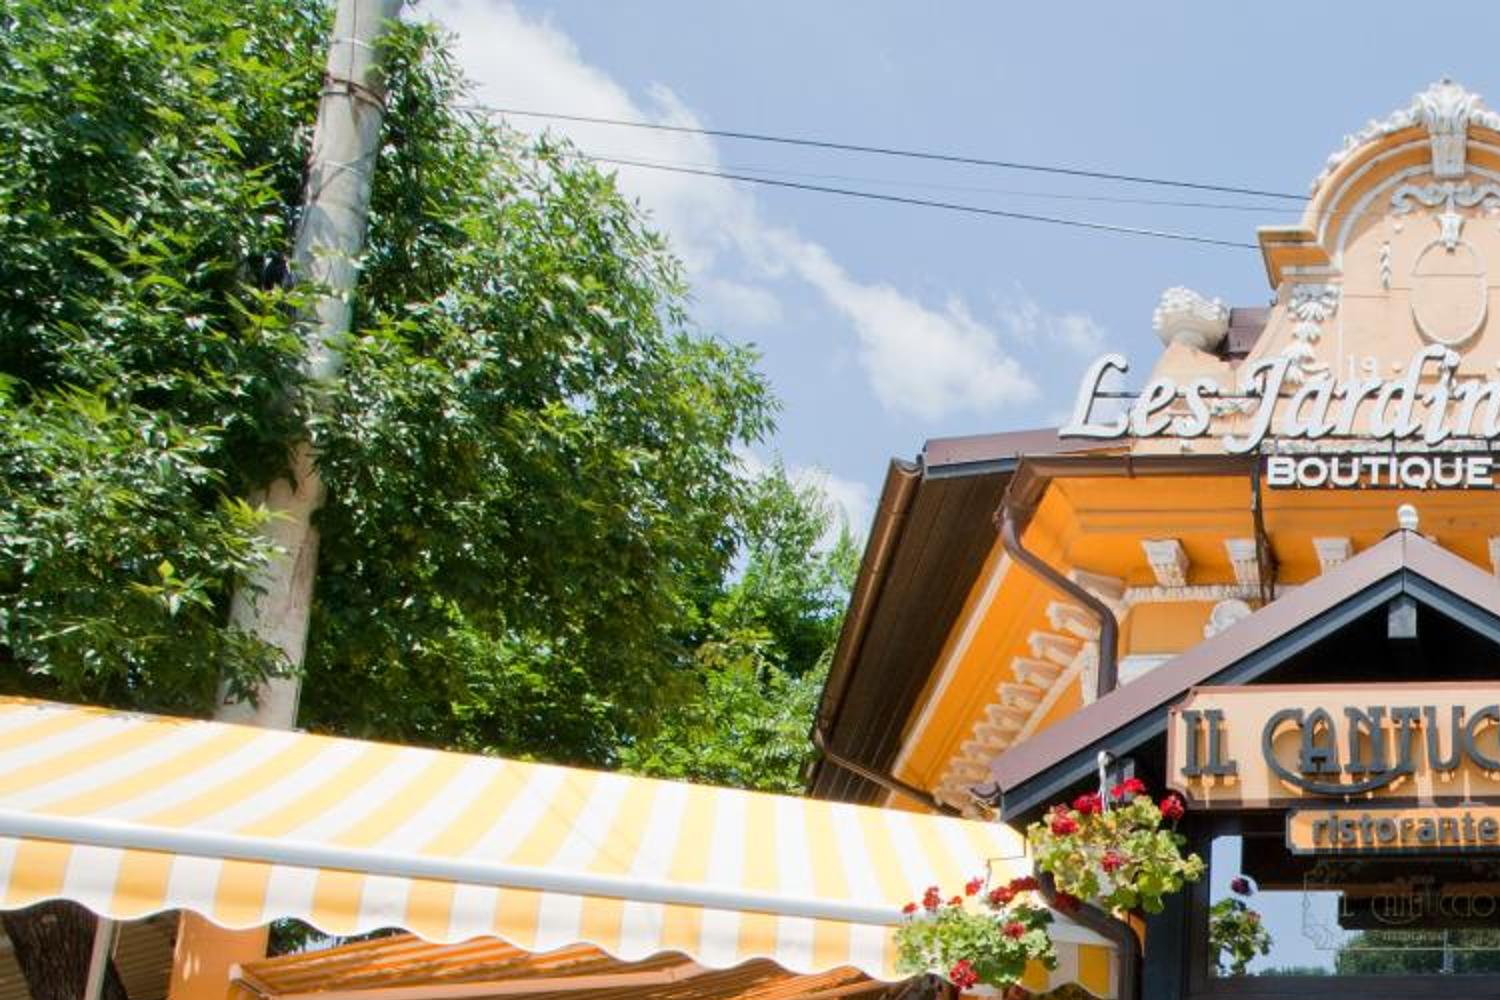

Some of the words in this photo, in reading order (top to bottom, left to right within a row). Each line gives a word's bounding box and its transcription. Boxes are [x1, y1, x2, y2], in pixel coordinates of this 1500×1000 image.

[1058, 352, 1219, 440] Les
[1266, 455, 1494, 489] BOUTIQUE
[1180, 708, 1238, 777] IL
[1311, 812, 1500, 845] ristorante
